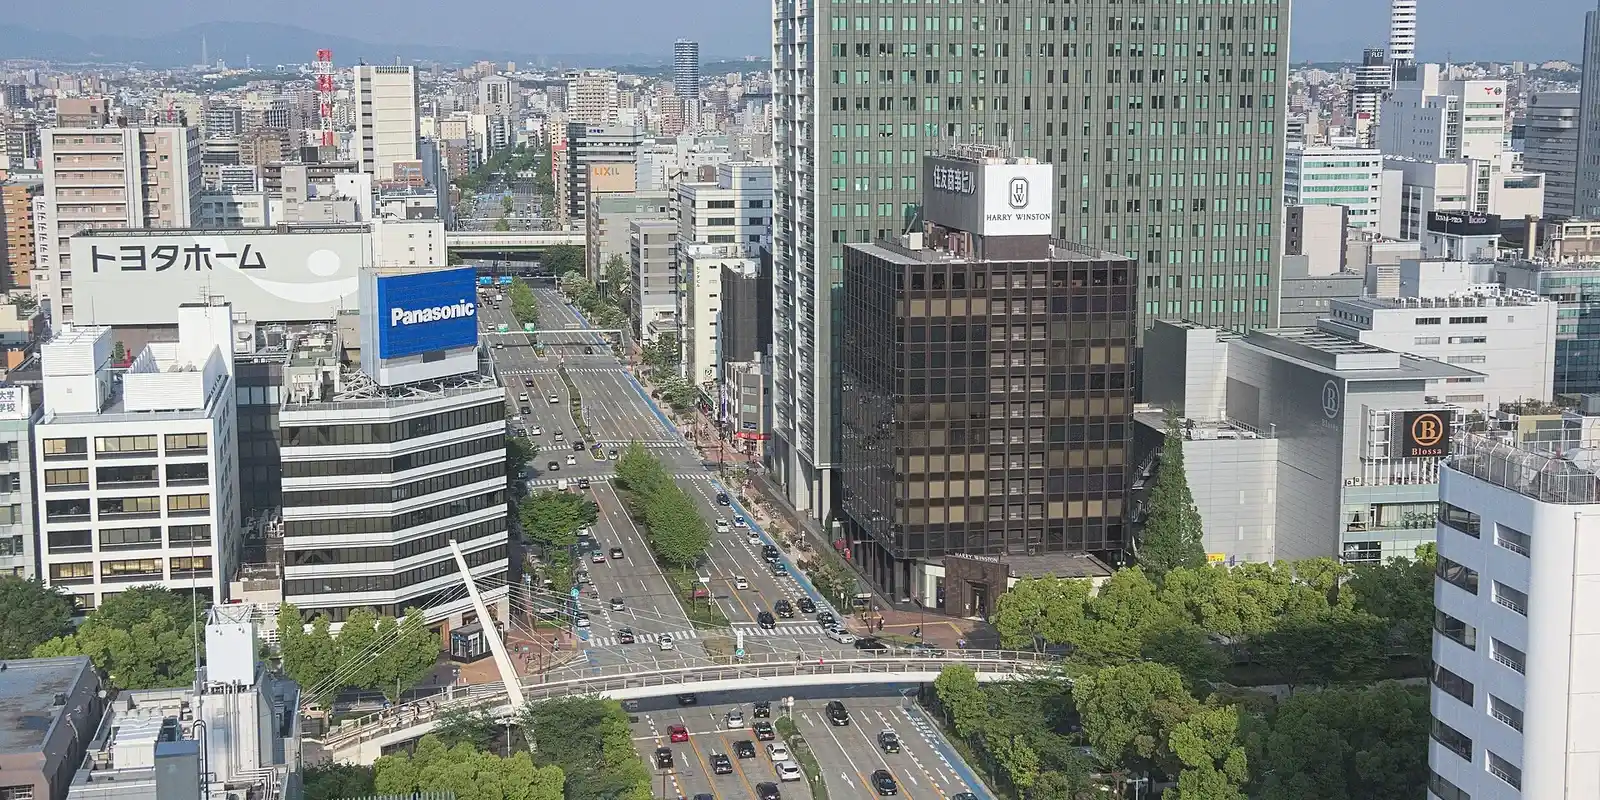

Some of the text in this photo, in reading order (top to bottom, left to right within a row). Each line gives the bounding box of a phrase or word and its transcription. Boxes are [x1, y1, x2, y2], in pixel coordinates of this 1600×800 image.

[594, 167, 620, 176] LIXIL
[933, 165, 977, 195] 住友商事ビル
[986, 213, 1051, 221] HARRY WINSTON
[91, 243, 267, 273] トヨタホーム
[391, 299, 475, 327] Panasonic
[1411, 447, 1442, 456] Blossa
